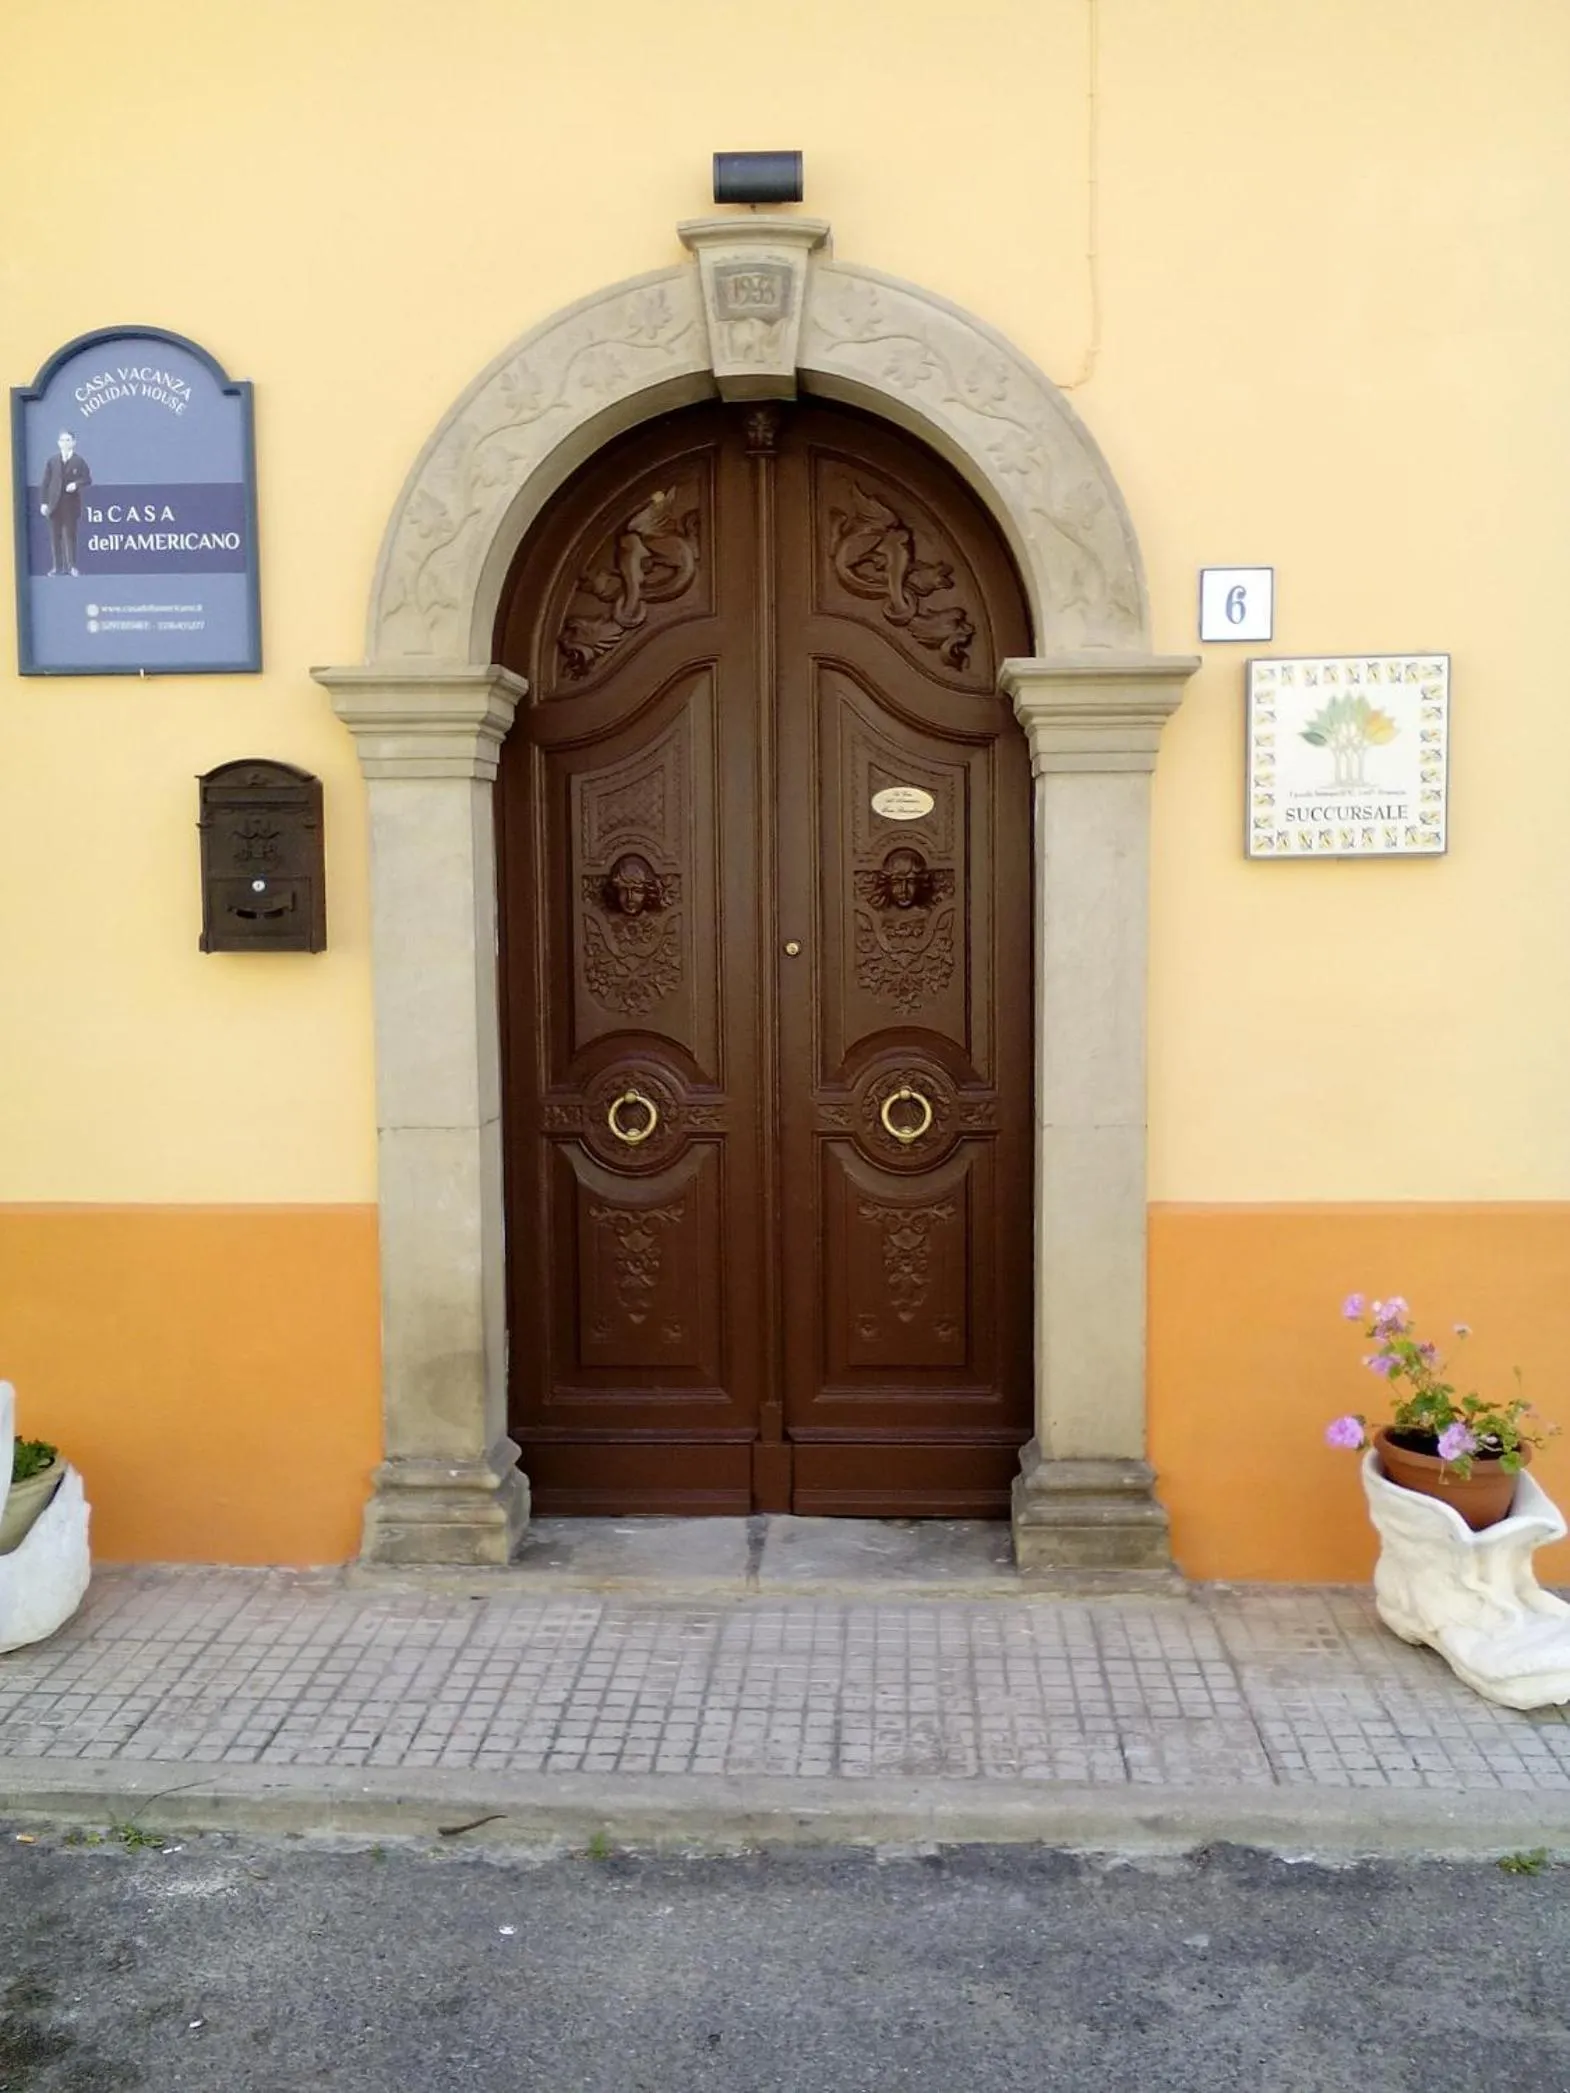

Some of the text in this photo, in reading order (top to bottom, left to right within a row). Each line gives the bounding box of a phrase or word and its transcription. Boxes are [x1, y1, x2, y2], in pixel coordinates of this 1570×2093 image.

[75, 367, 192, 402] CASA VACANZA
[80, 383, 187, 417] HOLIDAY HOUSE
[86, 504, 176, 523] la CASA
[87, 532, 241, 552] dell'AMERICANO
[1225, 584, 1247, 625] 6
[1285, 803, 1409, 822] SUCCURSALE
